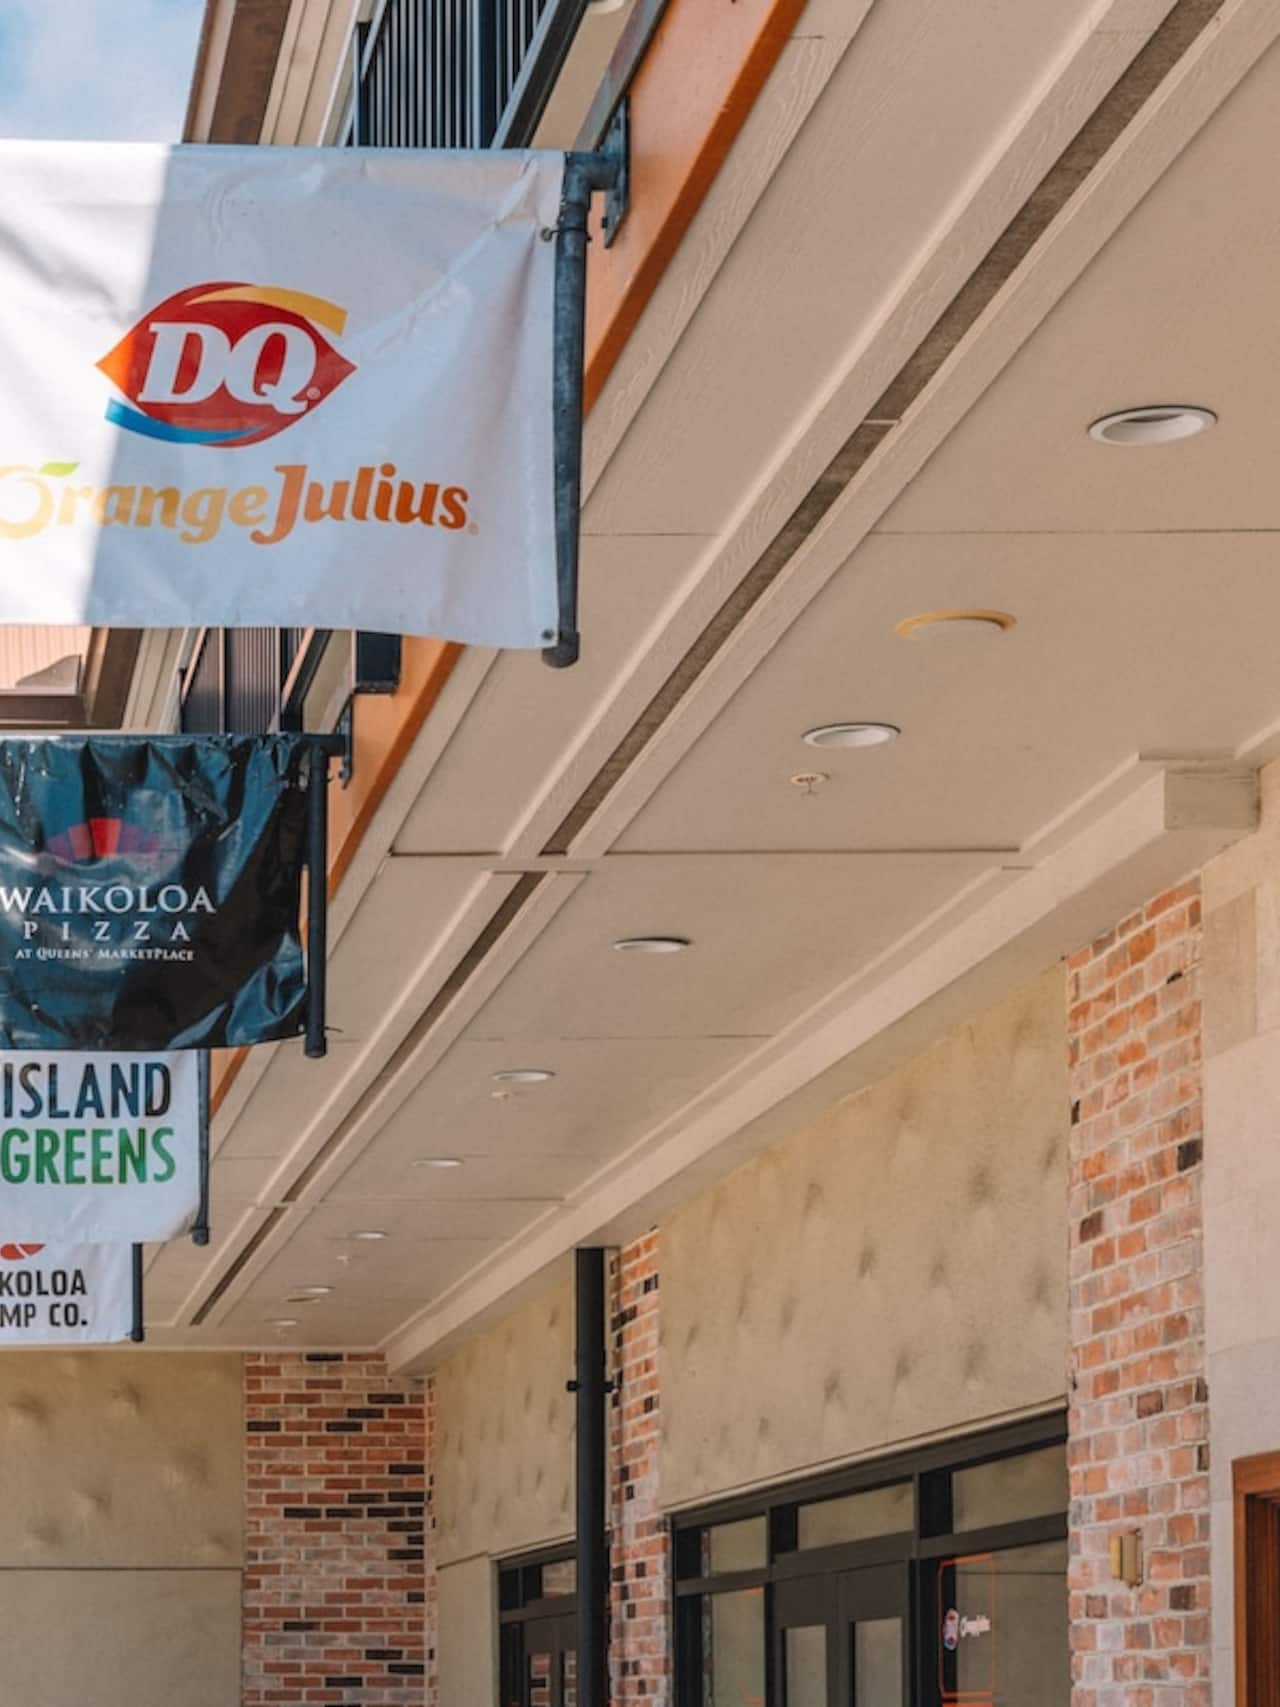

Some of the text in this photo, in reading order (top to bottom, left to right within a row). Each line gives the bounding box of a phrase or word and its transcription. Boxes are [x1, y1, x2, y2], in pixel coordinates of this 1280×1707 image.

[136, 322, 320, 415] DQ
[249, 462, 472, 545] Julius
[23, 920, 192, 942] PIZZA
[15, 949, 34, 960] AT
[2, 1062, 173, 1119] ISLAND
[48, 1302, 89, 1328] CO.
